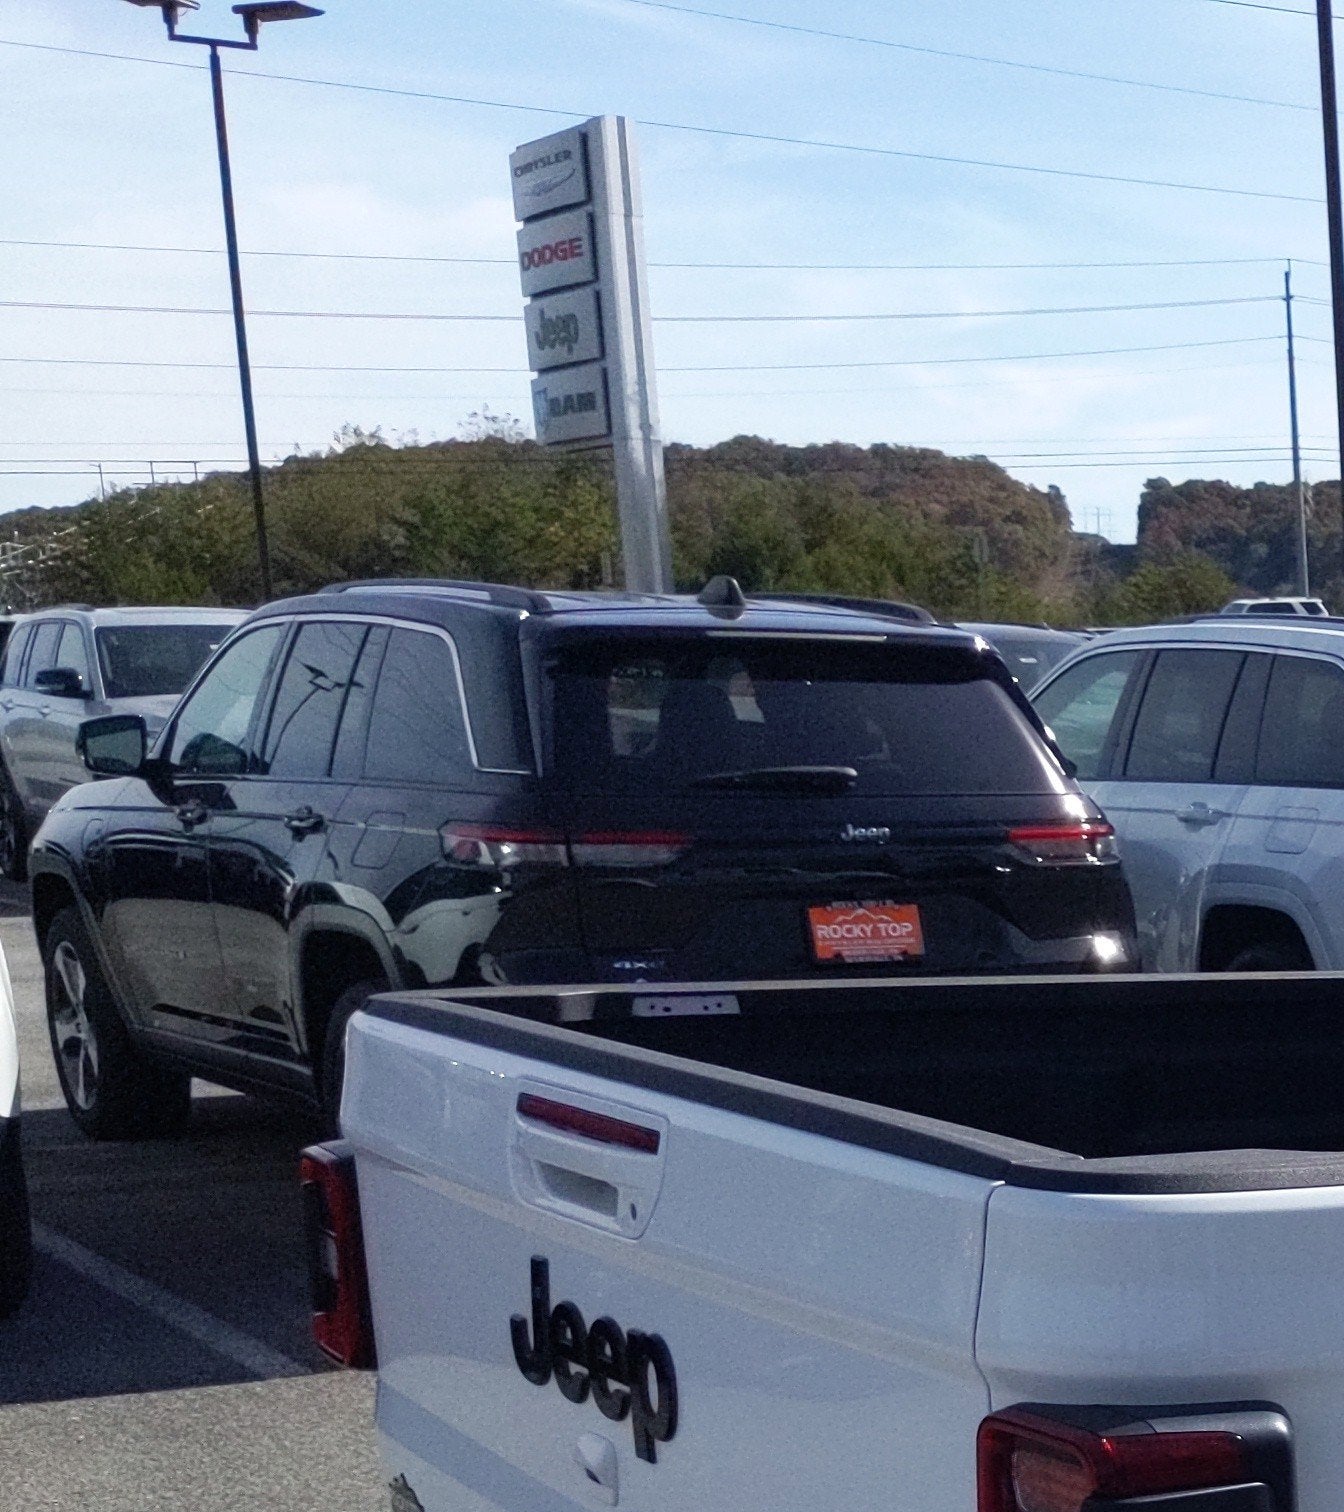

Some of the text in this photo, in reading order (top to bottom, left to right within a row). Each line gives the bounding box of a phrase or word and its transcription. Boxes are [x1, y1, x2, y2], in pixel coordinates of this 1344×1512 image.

[513, 148, 572, 177] CHRYSLER
[520, 237, 583, 272] DODGE
[535, 308, 579, 356] Jeep
[549, 391, 597, 416] RAM
[841, 823, 891, 844] Jeep
[816, 922, 913, 939] ROCKY TOP
[509, 1254, 679, 1464] Jeep
